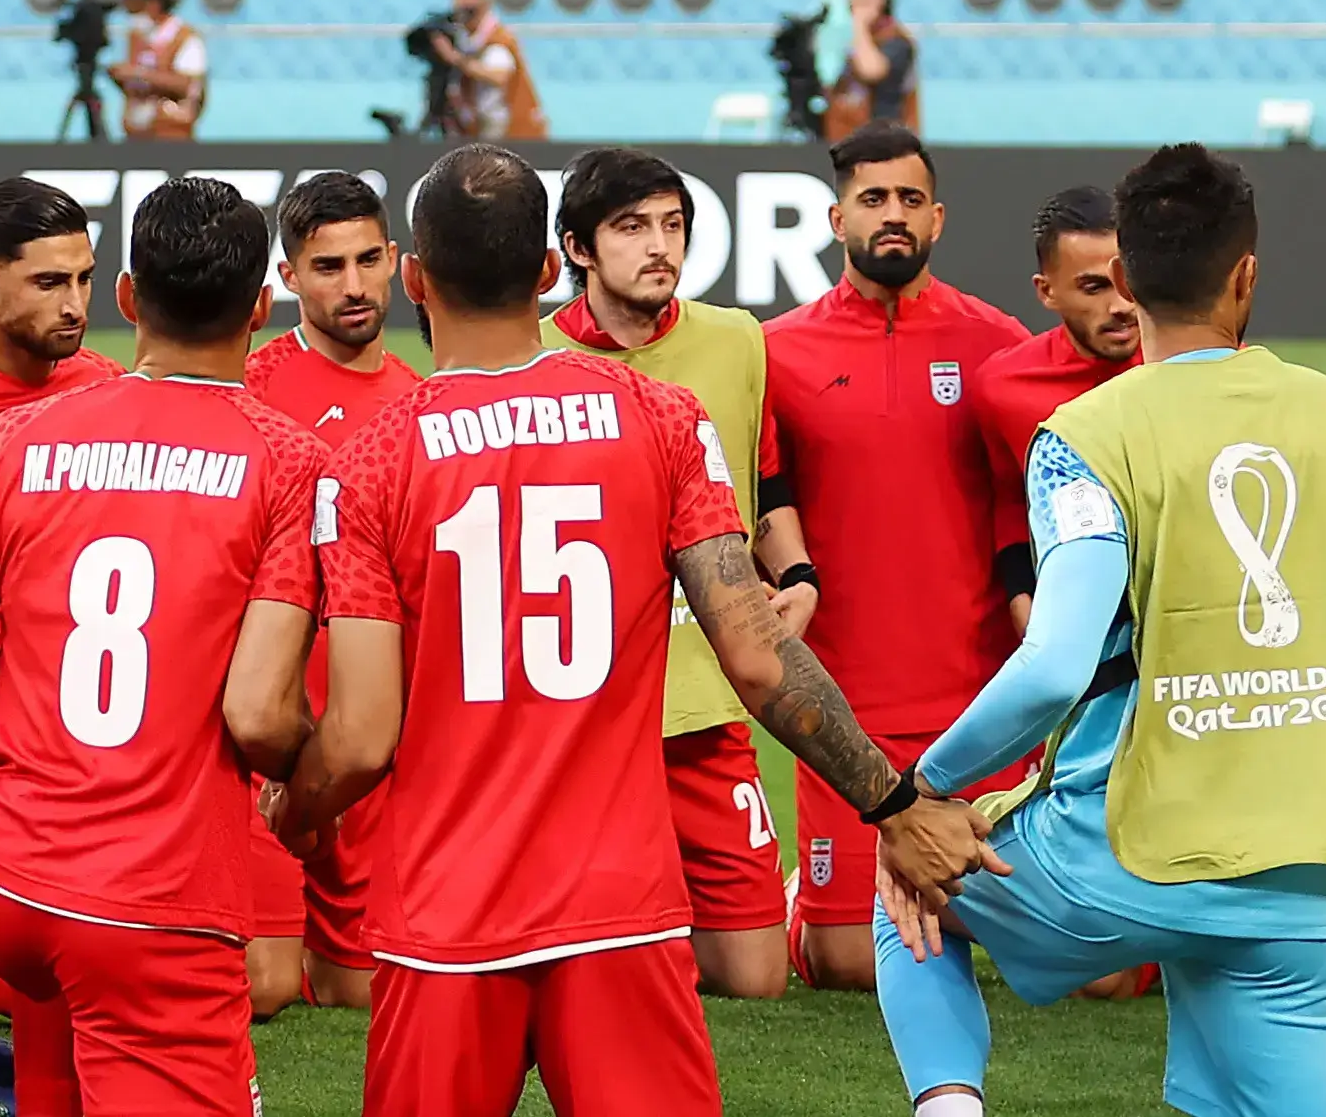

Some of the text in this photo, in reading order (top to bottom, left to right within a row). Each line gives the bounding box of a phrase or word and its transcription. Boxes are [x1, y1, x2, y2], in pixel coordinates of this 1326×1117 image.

[417, 393, 621, 460] ROUZBEH
[21, 442, 247, 499] M.POURALIGANJI
[435, 484, 613, 702] 15
[59, 535, 155, 748] 8
[1154, 673, 1221, 702] FIFA
